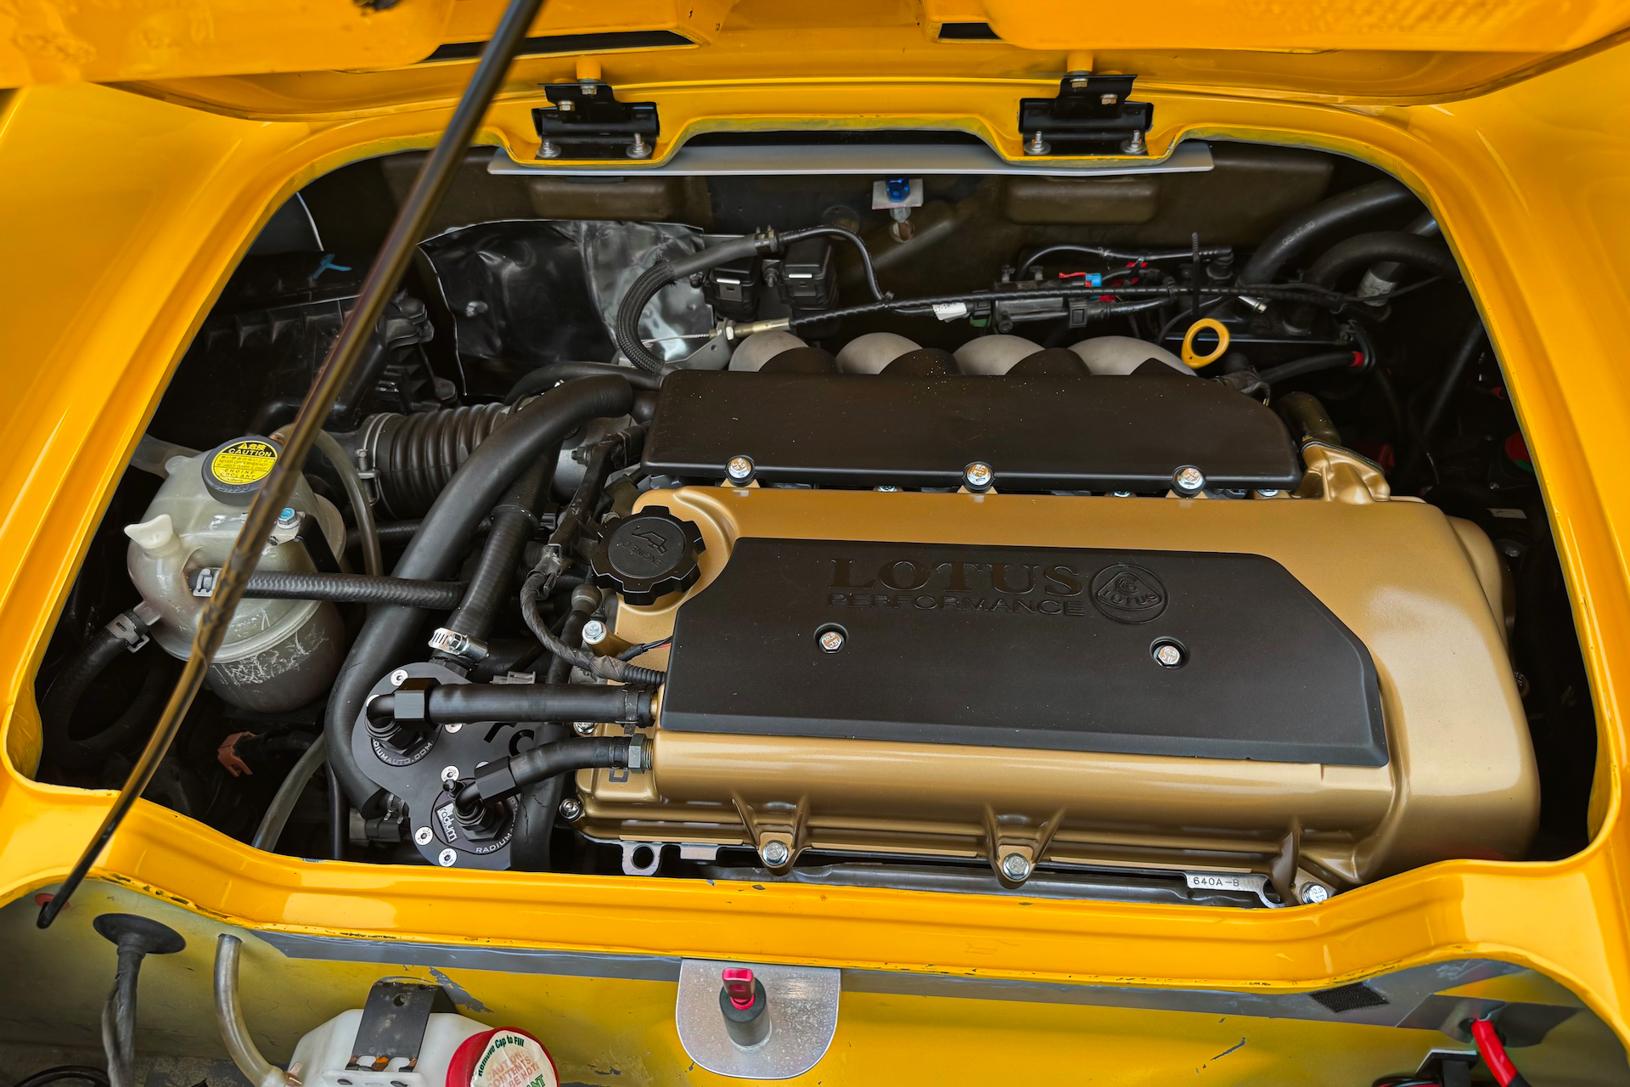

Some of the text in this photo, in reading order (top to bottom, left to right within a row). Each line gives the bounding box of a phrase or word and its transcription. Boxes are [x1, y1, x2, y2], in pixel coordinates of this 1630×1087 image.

[228, 448, 272, 457] CAUTION
[828, 559, 1084, 596] LOTUS
[828, 592, 1087, 616] PERFORMANCE
[1101, 589, 1158, 607] LOTUS
[372, 739, 433, 765] DIUMAUTO.COM
[495, 1037, 506, 1048] Cap
[507, 1035, 513, 1044] to
[514, 1036, 524, 1047] Fill
